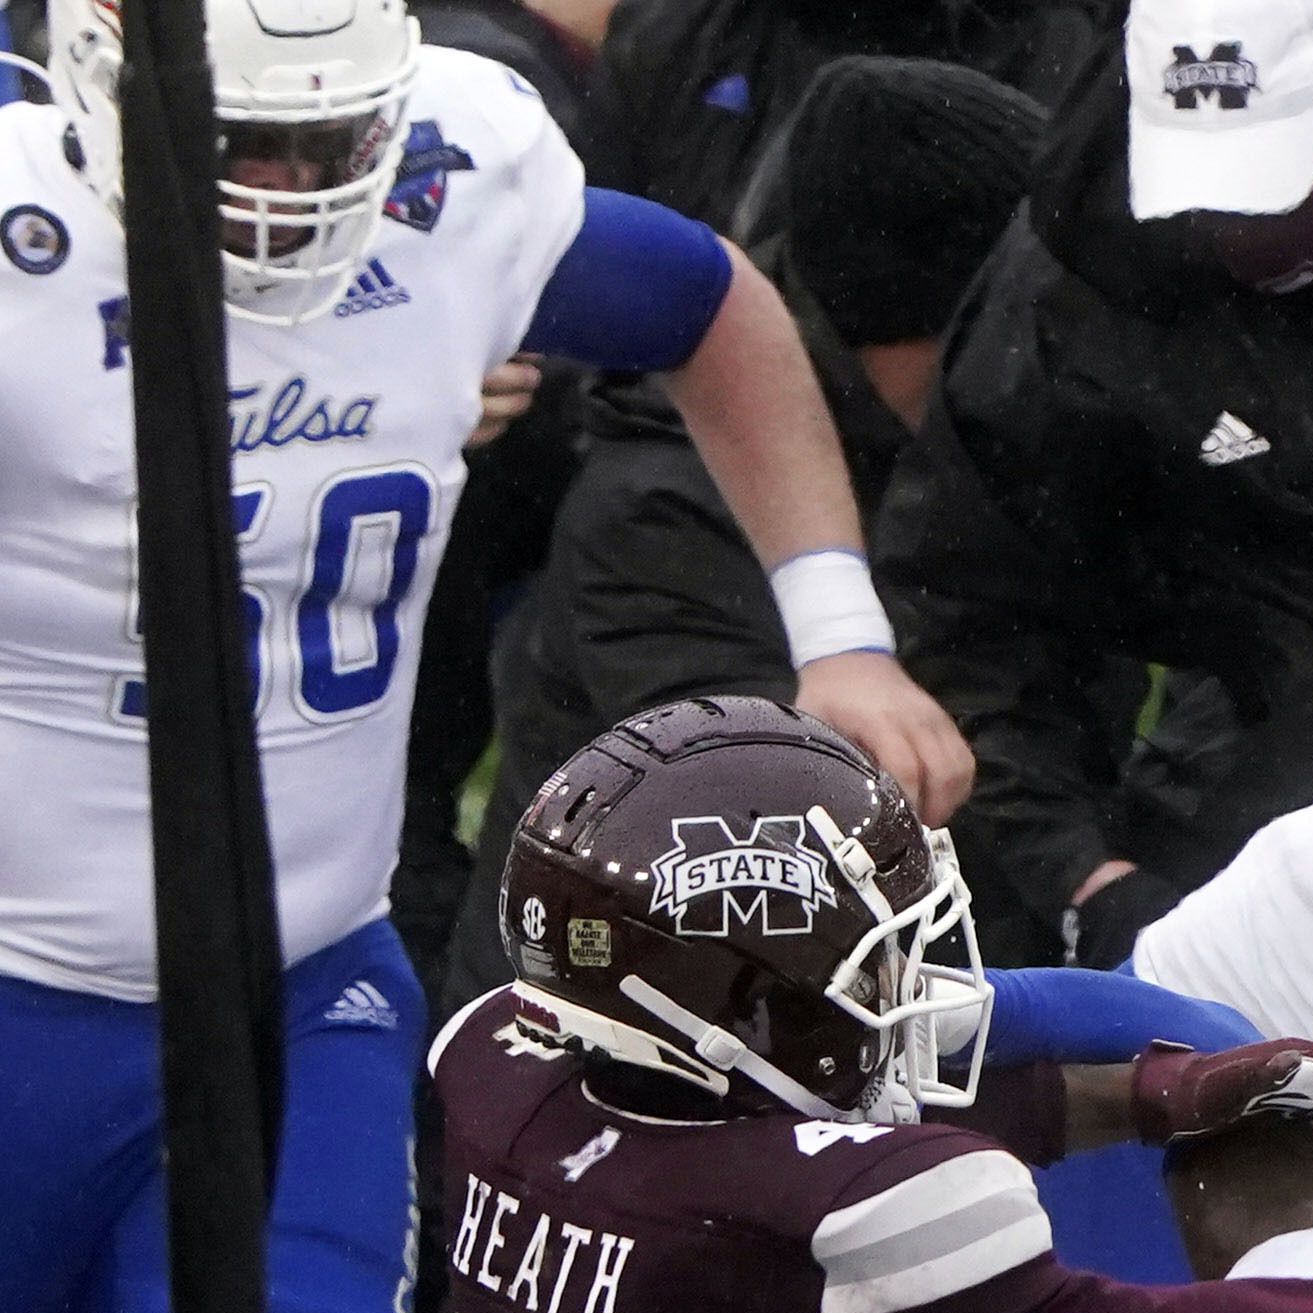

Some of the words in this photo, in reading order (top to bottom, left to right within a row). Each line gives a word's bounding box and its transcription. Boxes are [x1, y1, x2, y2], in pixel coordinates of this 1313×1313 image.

[230, 376, 380, 455] ulsa
[687, 854, 800, 890] STATE
[522, 897, 547, 942] SEC
